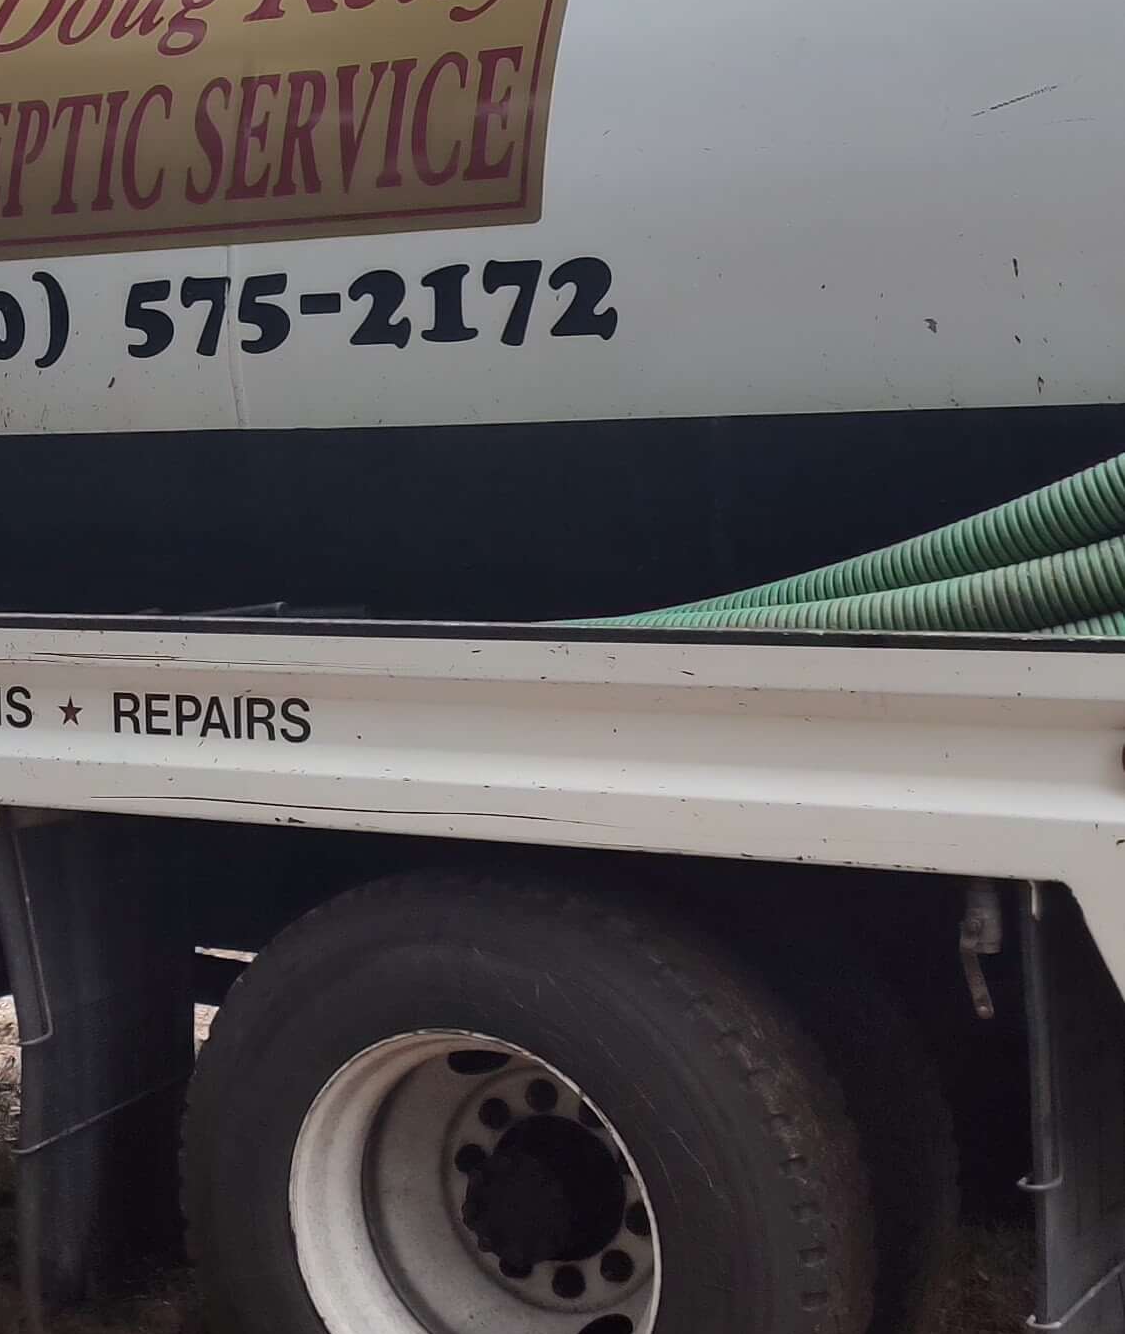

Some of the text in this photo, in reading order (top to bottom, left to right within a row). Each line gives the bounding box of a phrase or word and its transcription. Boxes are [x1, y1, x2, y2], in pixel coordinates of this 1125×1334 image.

[185, 46, 524, 205] SERVICE
[124, 256, 618, 359] 575-2172
[112, 690, 312, 744] REPAIRS
